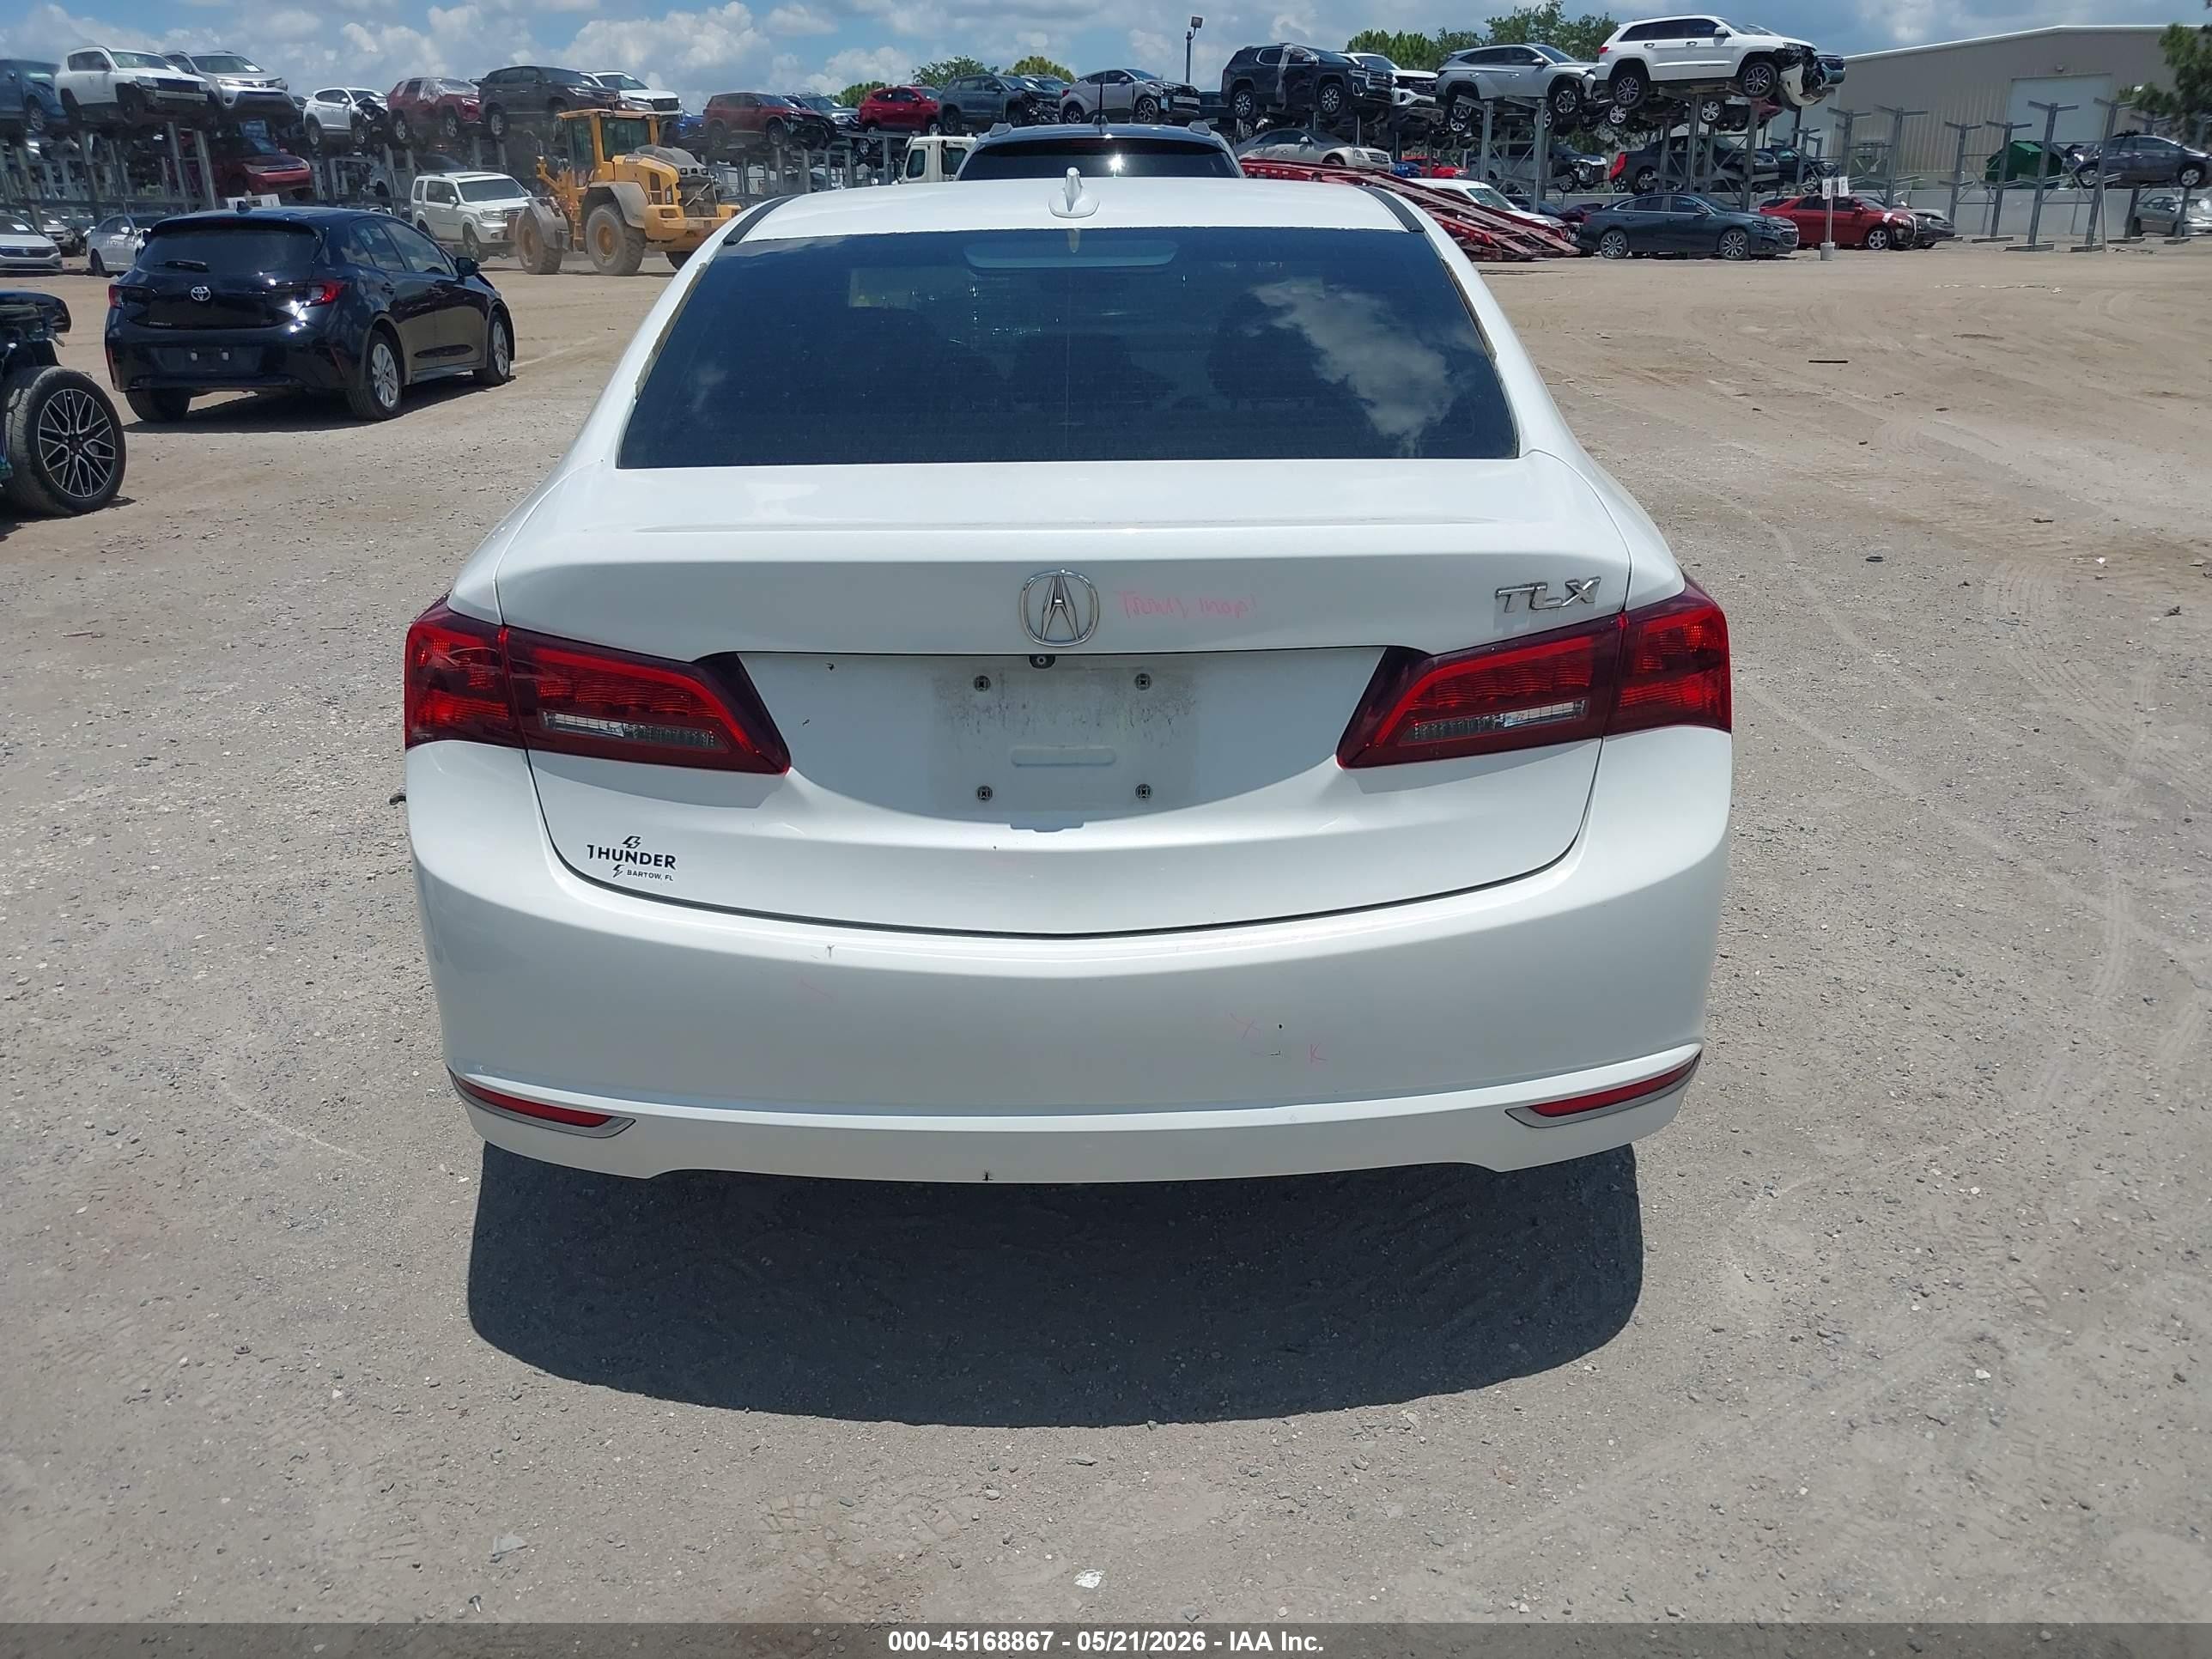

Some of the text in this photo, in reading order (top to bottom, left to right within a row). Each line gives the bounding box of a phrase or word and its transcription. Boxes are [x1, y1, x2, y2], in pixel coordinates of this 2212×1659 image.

[1495, 576, 1601, 612] TLX
[586, 844, 677, 870] THUNDER
[627, 869, 663, 880] BARTOW,
